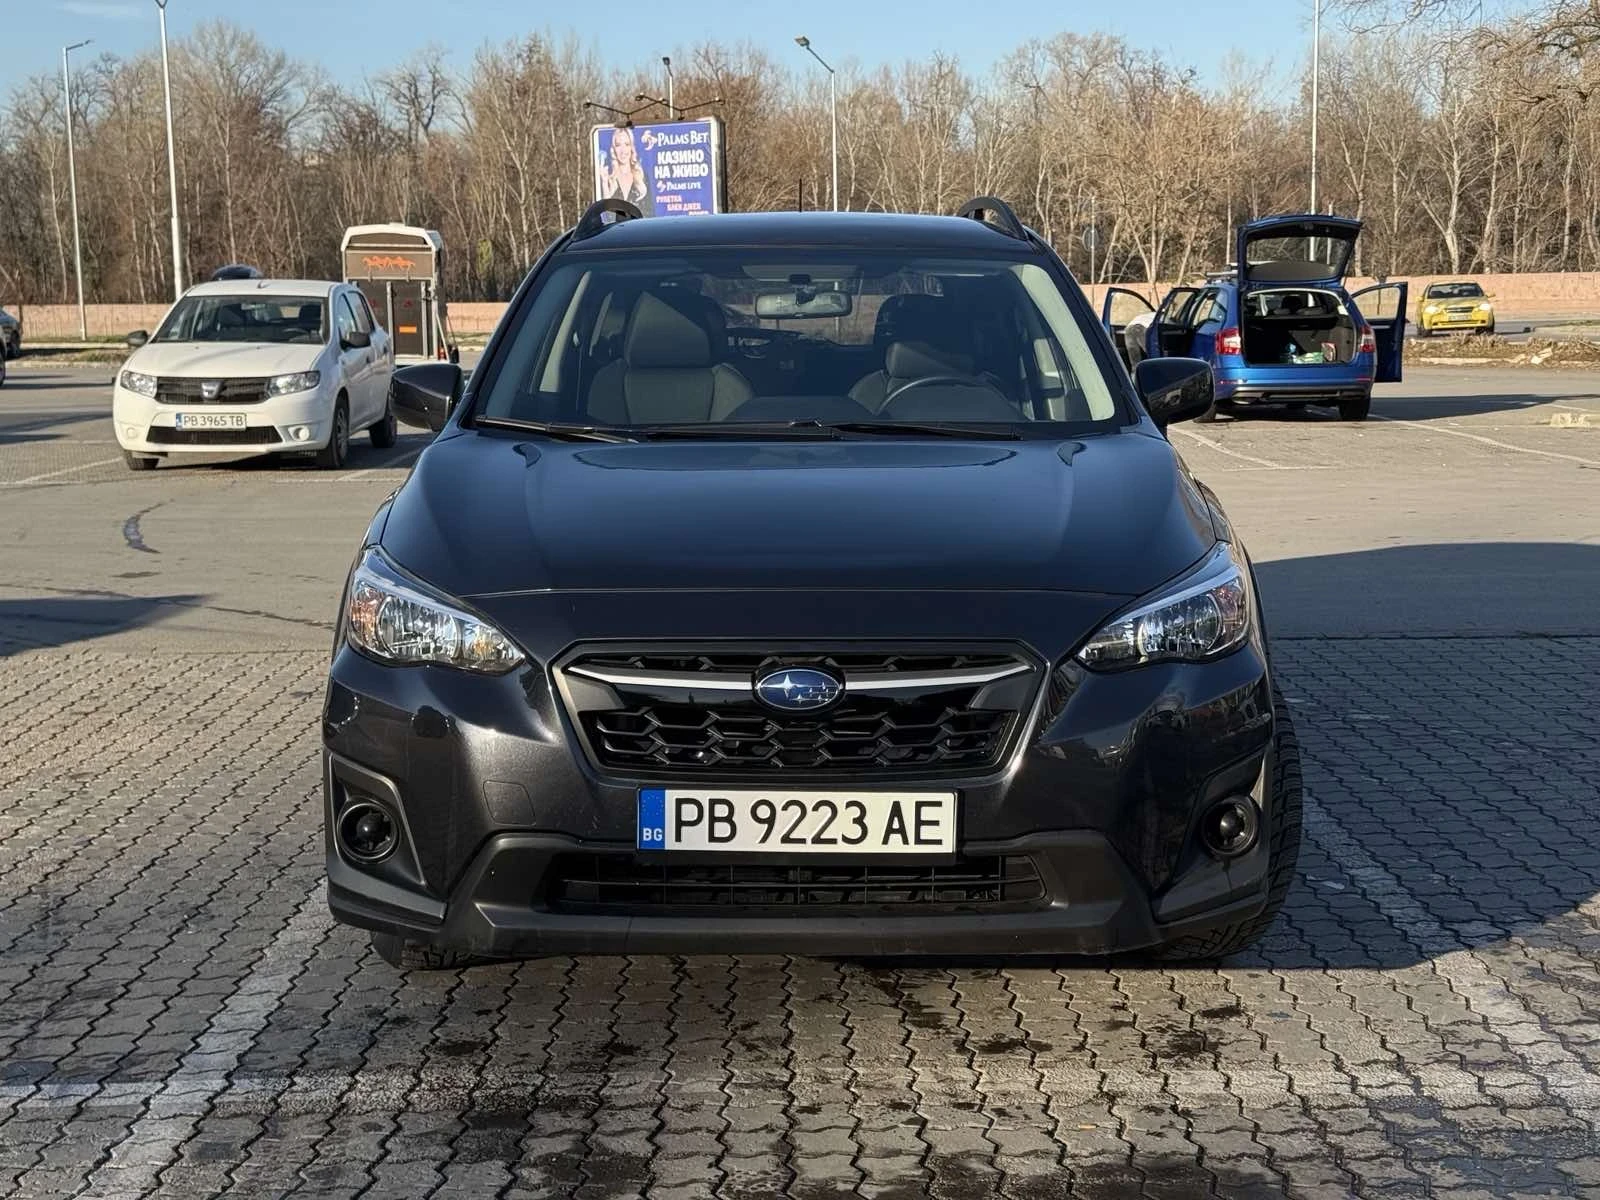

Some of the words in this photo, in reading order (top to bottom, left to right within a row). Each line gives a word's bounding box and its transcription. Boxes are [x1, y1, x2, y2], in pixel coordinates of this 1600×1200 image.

[657, 132, 689, 147] PALMS
[690, 130, 709, 145] BET
[657, 149, 704, 164] КАЗИНО
[654, 165, 671, 179] НА
[672, 163, 709, 178] ЖИВО
[184, 415, 198, 426] PB
[200, 415, 227, 426] 3965
[229, 415, 243, 426] TB
[674, 797, 737, 843] PB
[750, 798, 869, 845] 9223
[881, 800, 943, 845] AE
[643, 827, 663, 841] BG
